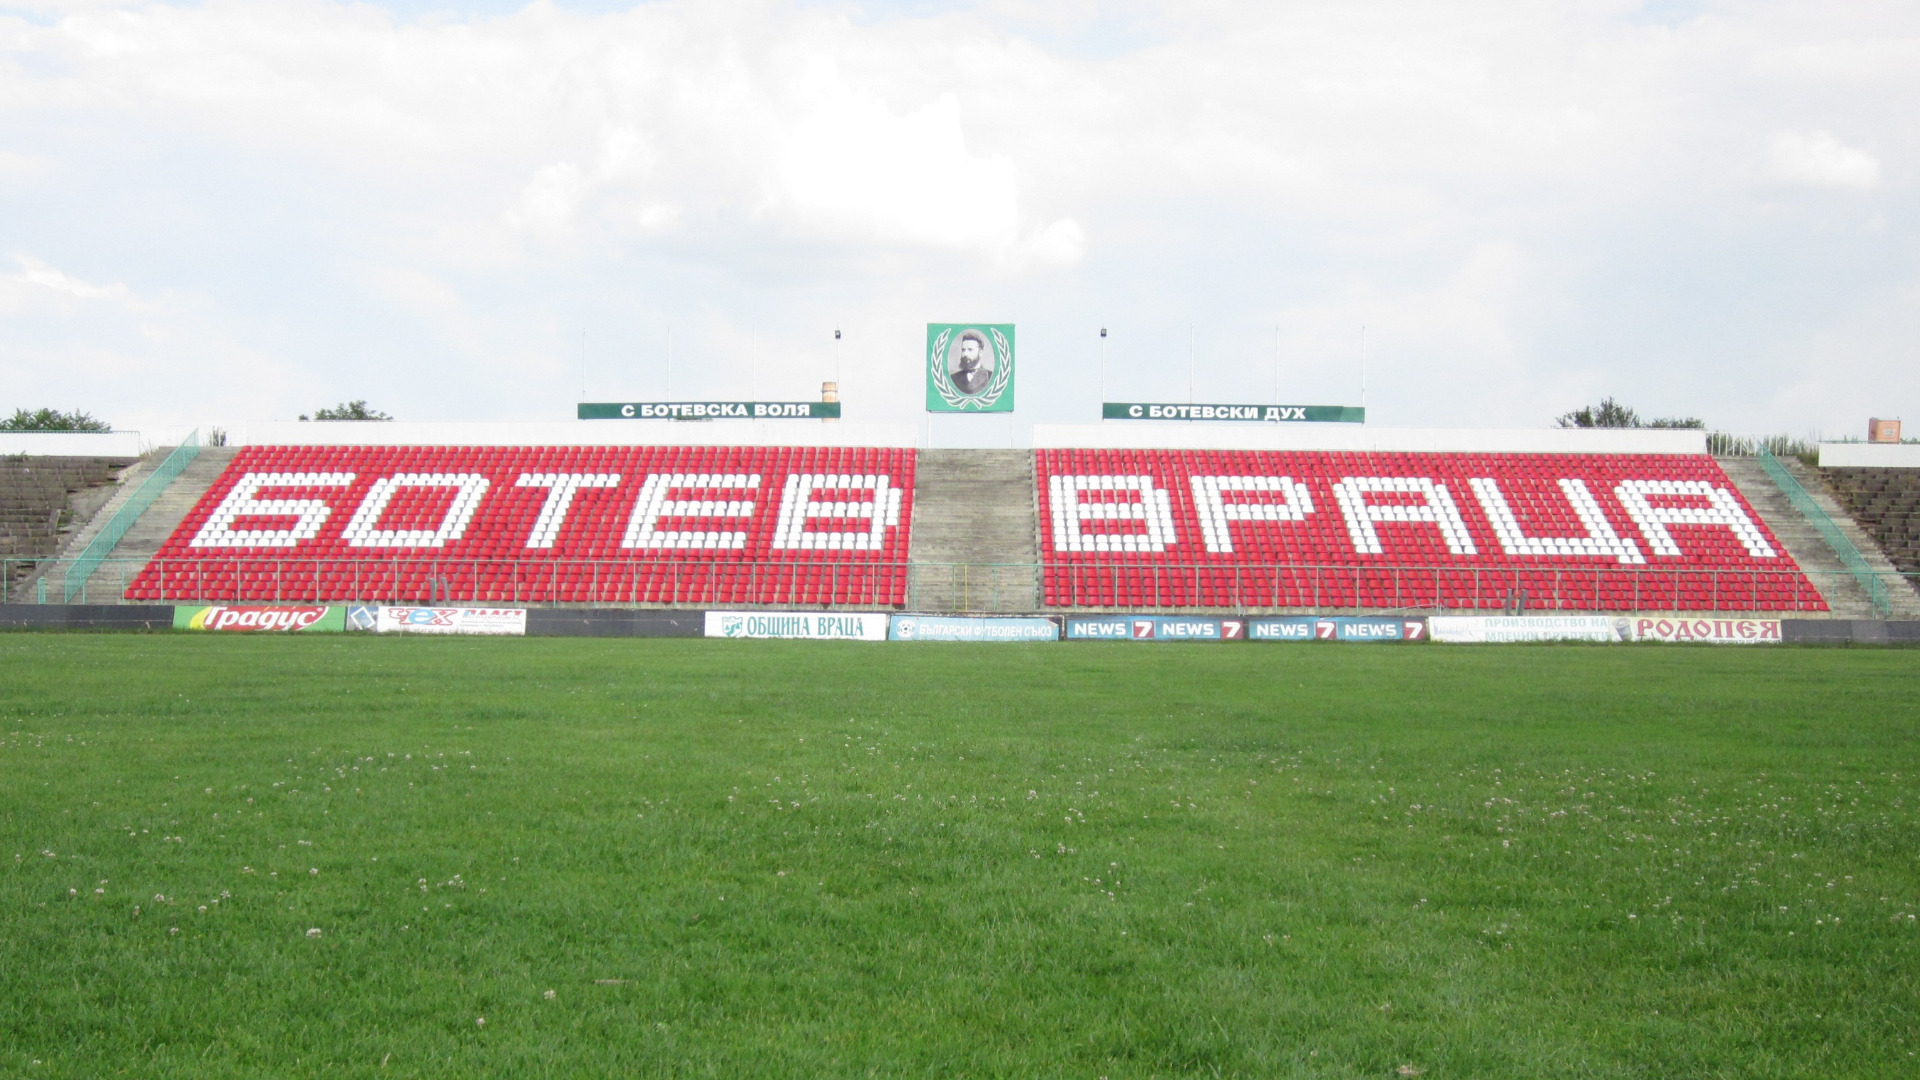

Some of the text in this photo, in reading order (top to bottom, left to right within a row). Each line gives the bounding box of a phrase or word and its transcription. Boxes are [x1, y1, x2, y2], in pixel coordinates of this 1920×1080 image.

[621, 403, 810, 417] С БОТЕВСКА ВОЛЯ
[1129, 405, 1306, 421] С БОТЕВСКИ ДУХ
[189, 472, 1777, 564] БОТЕВ ВРАЦА
[203, 606, 318, 631] Градус
[747, 616, 864, 637] ОБЩИНА ВРАЦА
[1484, 618, 1587, 629] ПРОИЗВОДСТВО
[1591, 618, 1608, 628] НА
[918, 624, 972, 637] БЪЛГАРСКИ
[1024, 625, 1053, 638] СЪЮЗ
[1074, 621, 1153, 638] NEWS 7
[1162, 621, 1241, 638] NEWS 7
[1256, 622, 1335, 639] NEWS 7
[1344, 624, 1397, 637] NEWS
[1405, 622, 1424, 639] 7
[1635, 618, 1780, 641] РОДОПЕЯ
